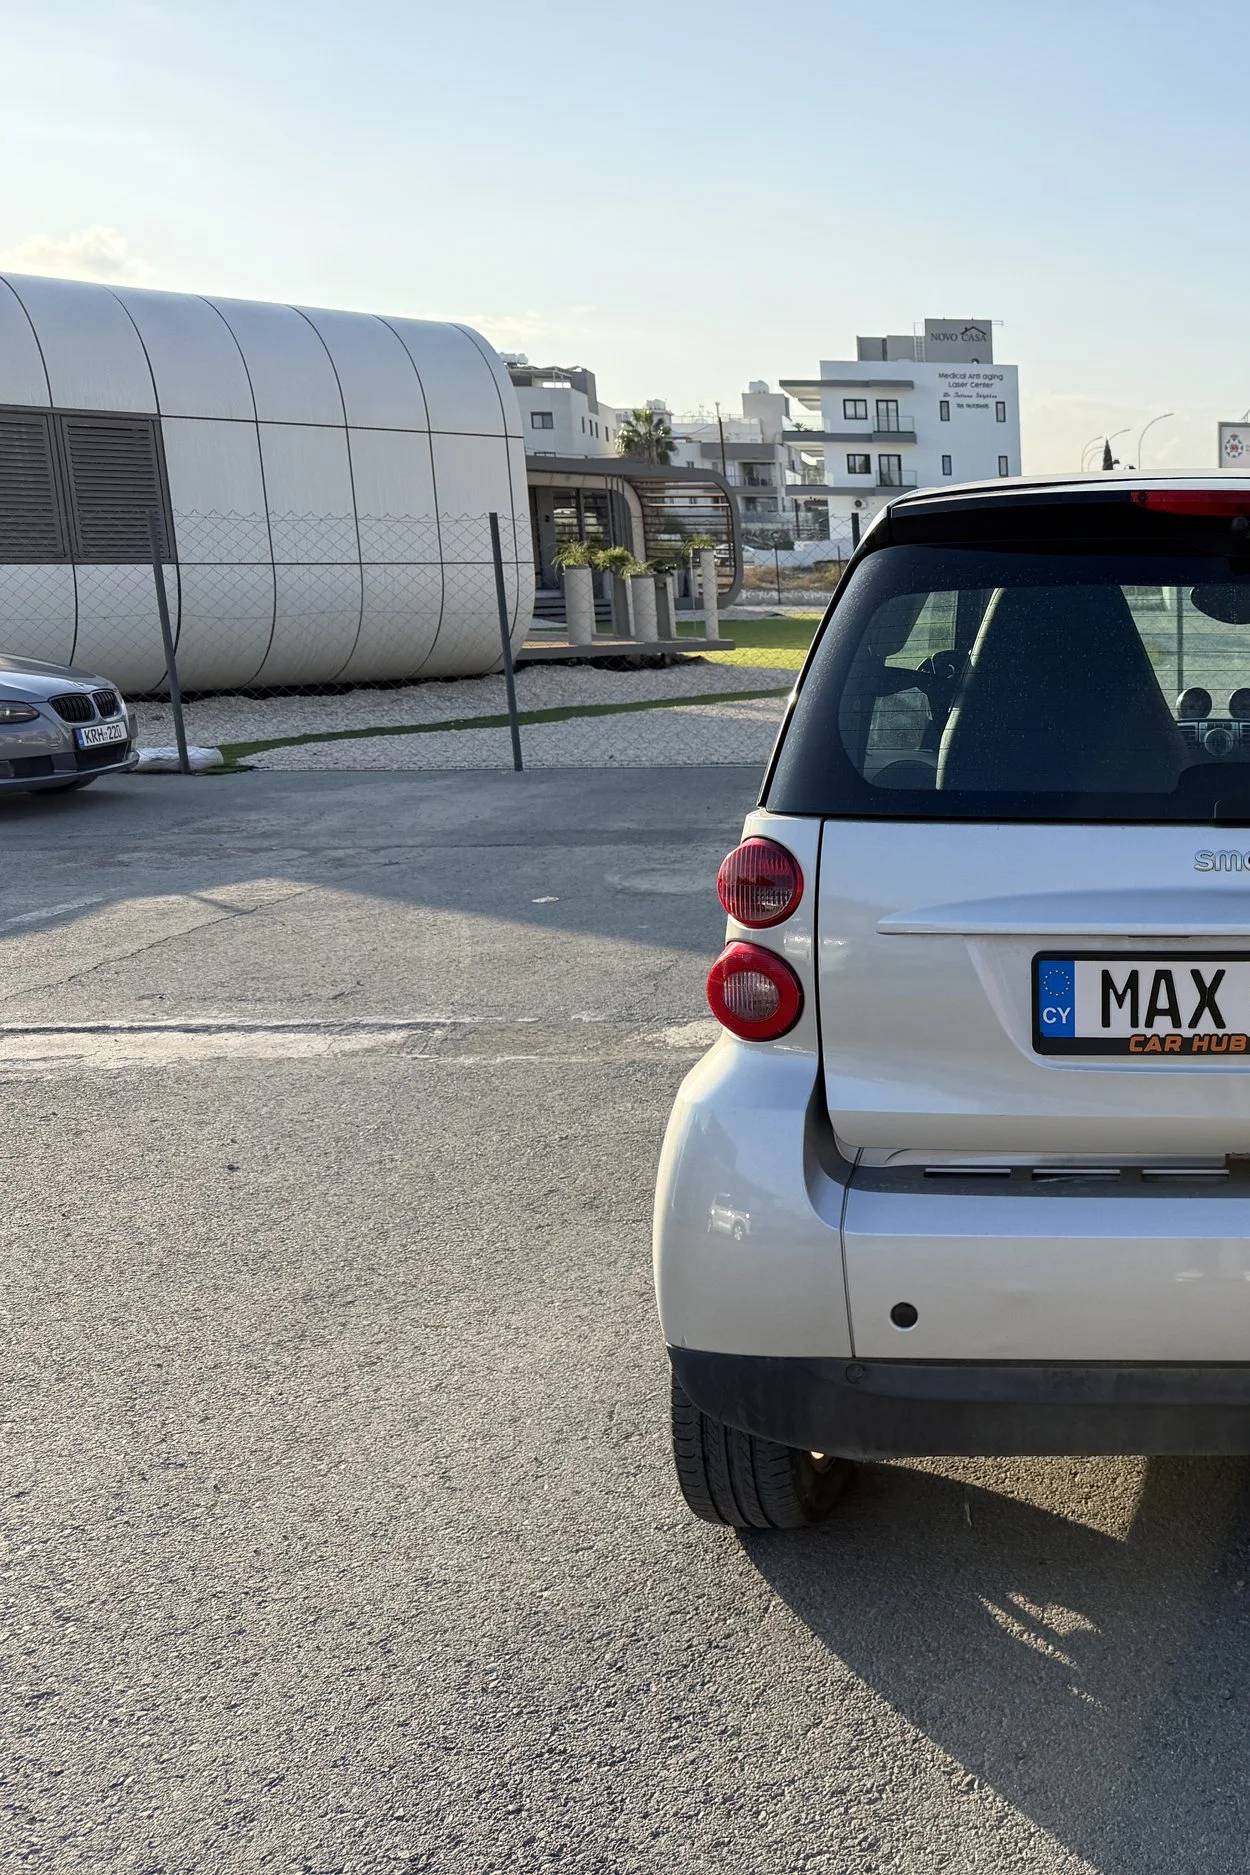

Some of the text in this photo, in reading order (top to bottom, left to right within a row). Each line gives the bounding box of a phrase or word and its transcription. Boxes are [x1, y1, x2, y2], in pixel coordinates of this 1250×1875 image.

[930, 333, 988, 342] NOVO CASA
[84, 728, 104, 744] KRH
[107, 724, 122, 740] 220
[1101, 969, 1226, 1029] MAX
[1042, 1007, 1071, 1024] CY
[1129, 1035, 1183, 1053] CAR
[1191, 1034, 1248, 1053] HUB
